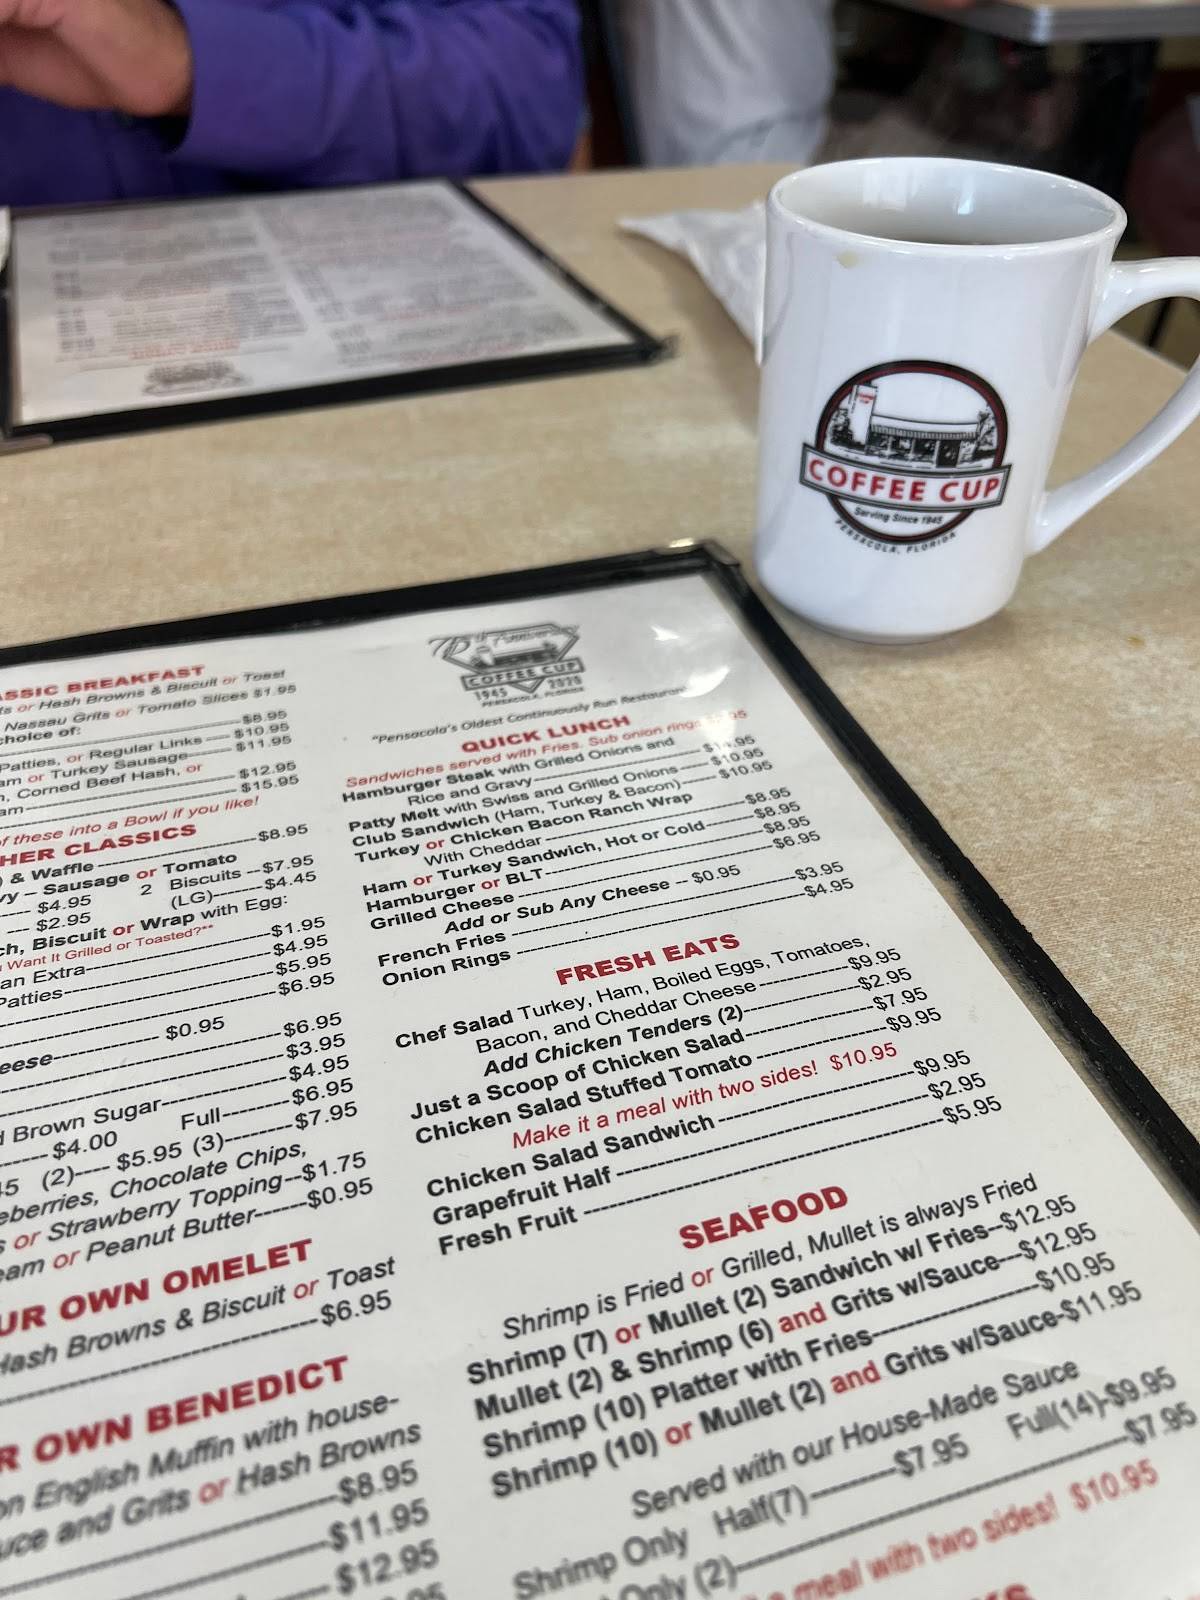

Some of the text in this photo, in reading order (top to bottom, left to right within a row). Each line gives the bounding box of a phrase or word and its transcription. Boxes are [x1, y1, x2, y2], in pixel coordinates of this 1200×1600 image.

[808, 458, 1001, 503] COFFEE CUP
[854, 507, 943, 526] Serving Since 1945
[468, 661, 577, 687] COFFEE CUP
[65, 753, 84, 764] or
[88, 743, 154, 761] Regular
[159, 736, 203, 751] Links
[233, 721, 291, 740] $10.95
[371, 723, 459, 745] "Pensacola's
[460, 716, 504, 732] Oldest
[505, 702, 591, 724] Continuously
[591, 698, 618, 710] Run
[460, 715, 631, 754] QUICK LUNCH
[238, 760, 297, 780] $12.95
[240, 774, 300, 794] $15.95
[341, 736, 676, 803] Hamburger Steak with Grilled Onions and
[348, 816, 397, 833] Patty
[400, 806, 441, 824] Melt
[442, 800, 478, 816] with
[480, 792, 531, 809] Swiss
[533, 783, 565, 799] and
[567, 774, 620, 793] Grilled
[621, 765, 680, 783] Onions
[9, 823, 309, 885] & Waffle $8.95
[63, 823, 197, 857] CLASSICS
[353, 792, 694, 863] Turkey or Chicken Bacon Ranch Wrap
[423, 786, 792, 867] With Cheddar $8.95
[37, 853, 315, 916] $4.95 2 Biscuits $7.95
[365, 815, 811, 914] Hamburger or BLT $8.95
[369, 829, 822, 931] Grilled Cheese $6.95
[443, 863, 742, 935] Add or Sub Any Cheese $0.95
[377, 860, 845, 968] French Fries $3.95
[381, 876, 855, 987] Onion Rings $4.95
[6, 955, 47, 971] Want
[50, 952, 61, 964] It
[64, 942, 113, 961] Grilled
[116, 940, 133, 952] or
[275, 951, 332, 978] $5.95
[277, 971, 336, 997] $6.95
[555, 933, 741, 987] FRESH EATS
[394, 937, 871, 1049] Chef Salad Turkey, Ham, Boiled Eggs, Tomatoes,
[483, 966, 913, 1078] Add Chicken Tenders (2) $2.95
[12, 1115, 86, 1144] Brown
[93, 1098, 163, 1125] Sugar
[288, 1054, 350, 1084] $4.95
[415, 1006, 943, 1145] Chicken Salad Stuffed Tomato $9.95
[512, 1041, 898, 1150] Make it a meal with two sides! $10.95
[426, 1049, 971, 1198] Chicken Salad Sandwich $9.95
[432, 1071, 987, 1226] Grapefruit Half $2.95
[12, 1230, 42, 1251] or
[47, 1197, 182, 1243] Strawberry
[188, 1174, 283, 1209] Topping
[301, 1150, 367, 1184] $1.75
[437, 1094, 1003, 1256] Fresh Fruit $5.95
[52, 1176, 374, 1271] or Peanut Butter $0.95
[678, 1185, 849, 1250] SEAFOOD
[59, 1277, 150, 1321] OWN
[162, 1237, 313, 1295] OMELET
[482, 1250, 1116, 1460] Shrimp (10) Platter with Fries $10.95
[33, 1354, 349, 1464] OWN BENEDICT
[631, 1360, 1081, 1520] Served with our House-Made Sauce
[335, 1458, 419, 1507] $8.95
[326, 1496, 430, 1553] $11.95
